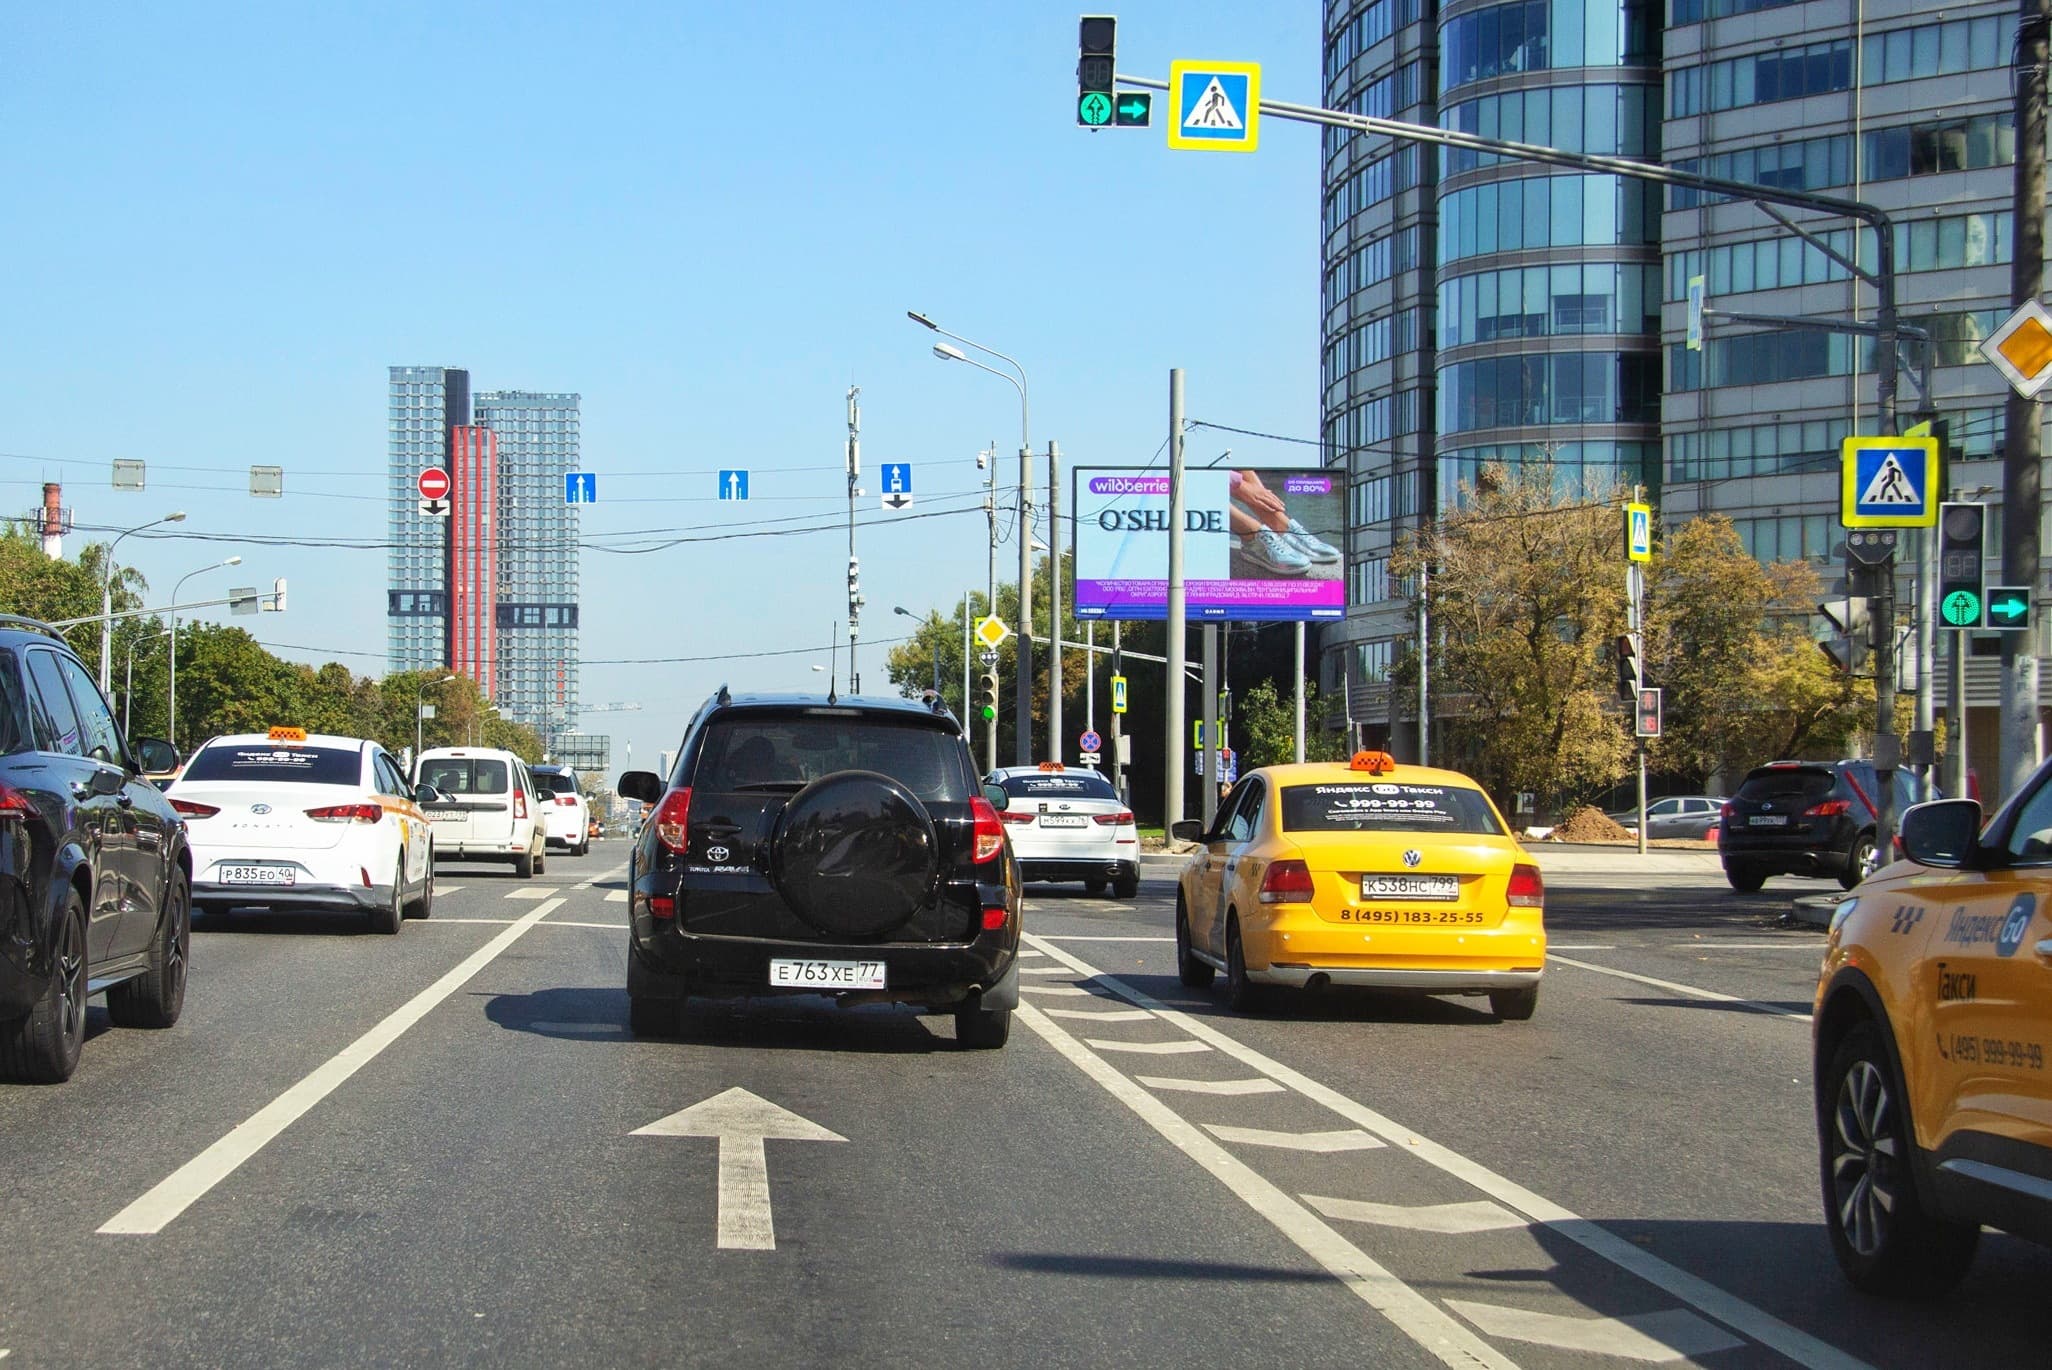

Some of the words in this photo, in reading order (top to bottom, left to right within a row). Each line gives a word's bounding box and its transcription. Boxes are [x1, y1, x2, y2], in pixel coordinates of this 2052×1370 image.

[1095, 479, 1169, 492] wildberrie
[1099, 509, 1223, 531] O'SHDE
[1315, 786, 1371, 794] Яндекс
[1400, 786, 1443, 795] Такси
[1349, 799, 1435, 807] 999-99-99
[1432, 876, 1454, 890] 799
[1341, 909, 1351, 920] 8
[1355, 910, 1399, 923] (495)
[1403, 911, 1484, 923] 183-25-55
[1944, 906, 2003, 948] Яндекс
[2000, 905, 2027, 944] Go
[860, 963, 879, 977] 77
[1937, 962, 1977, 1001] Такси
[1950, 1033, 1981, 1064] (495)
[1982, 1037, 2043, 1070] 999-99-99
